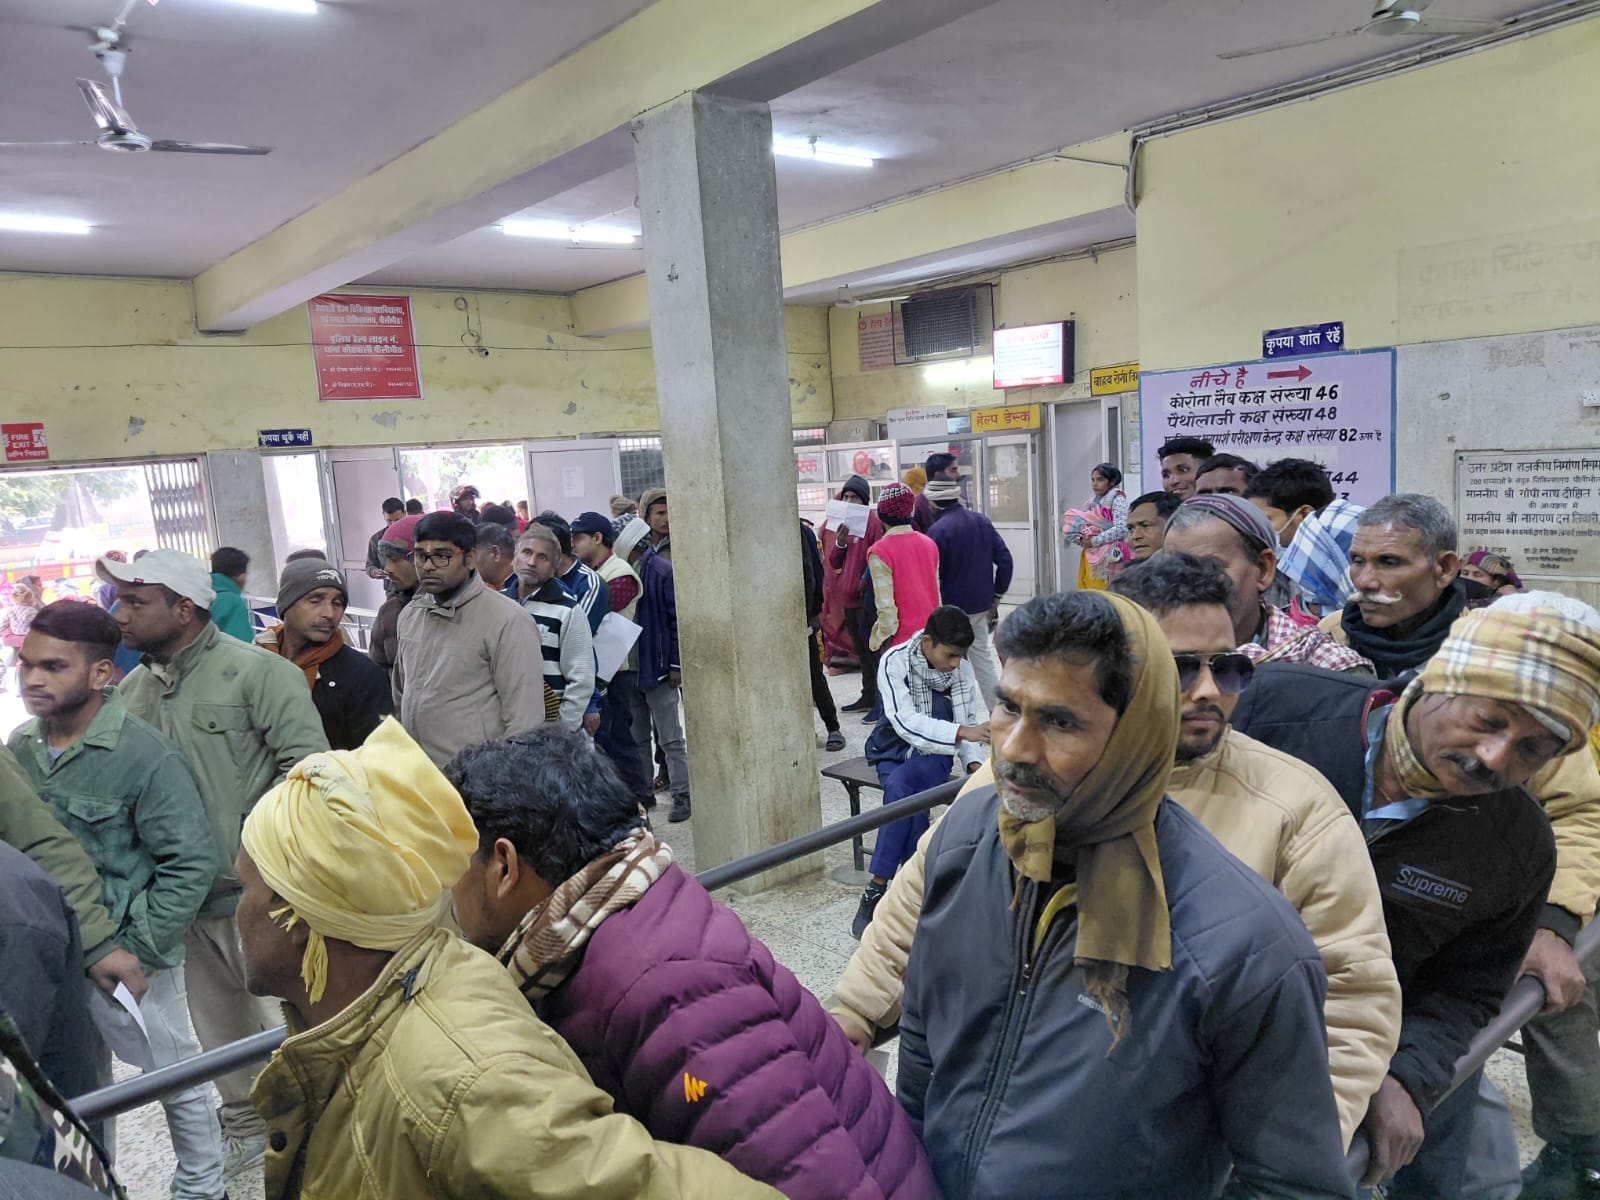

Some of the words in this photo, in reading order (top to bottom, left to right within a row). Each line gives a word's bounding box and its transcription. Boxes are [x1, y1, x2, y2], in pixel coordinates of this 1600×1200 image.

[1265, 336, 1294, 355] कृपया
[1299, 329, 1321, 346] शांत
[1326, 326, 1342, 343] रहें
[1190, 369, 1231, 388] नीचे
[1170, 391, 1212, 409] कोरोना
[1214, 388, 1237, 407] लैब
[1239, 390, 1266, 406] कक्ष
[1270, 385, 1312, 403] संख्या
[1316, 384, 1339, 400] 46
[976, 411, 998, 427] हेल्प
[1004, 409, 1030, 425] डेस्क
[1240, 410, 1269, 426] कक्ष
[1272, 406, 1313, 424] संख्या
[1315, 406, 1337, 420] 48
[11, 433, 30, 441] FIRE
[1285, 430, 1305, 445] कक्ष
[1307, 426, 1338, 444] संख्या
[1339, 428, 1358, 441] 82
[13, 441, 30, 449] EXIT
[1517, 459, 1552, 472] राजकीय
[1331, 471, 1359, 484] 44
[1466, 488, 1499, 499] माननीय
[1504, 487, 1514, 499] श्री
[1520, 487, 1540, 499] गोपी
[1467, 511, 1501, 524] माननीय
[1506, 511, 1517, 524] श्री
[1397, 868, 1468, 903] Supreme
